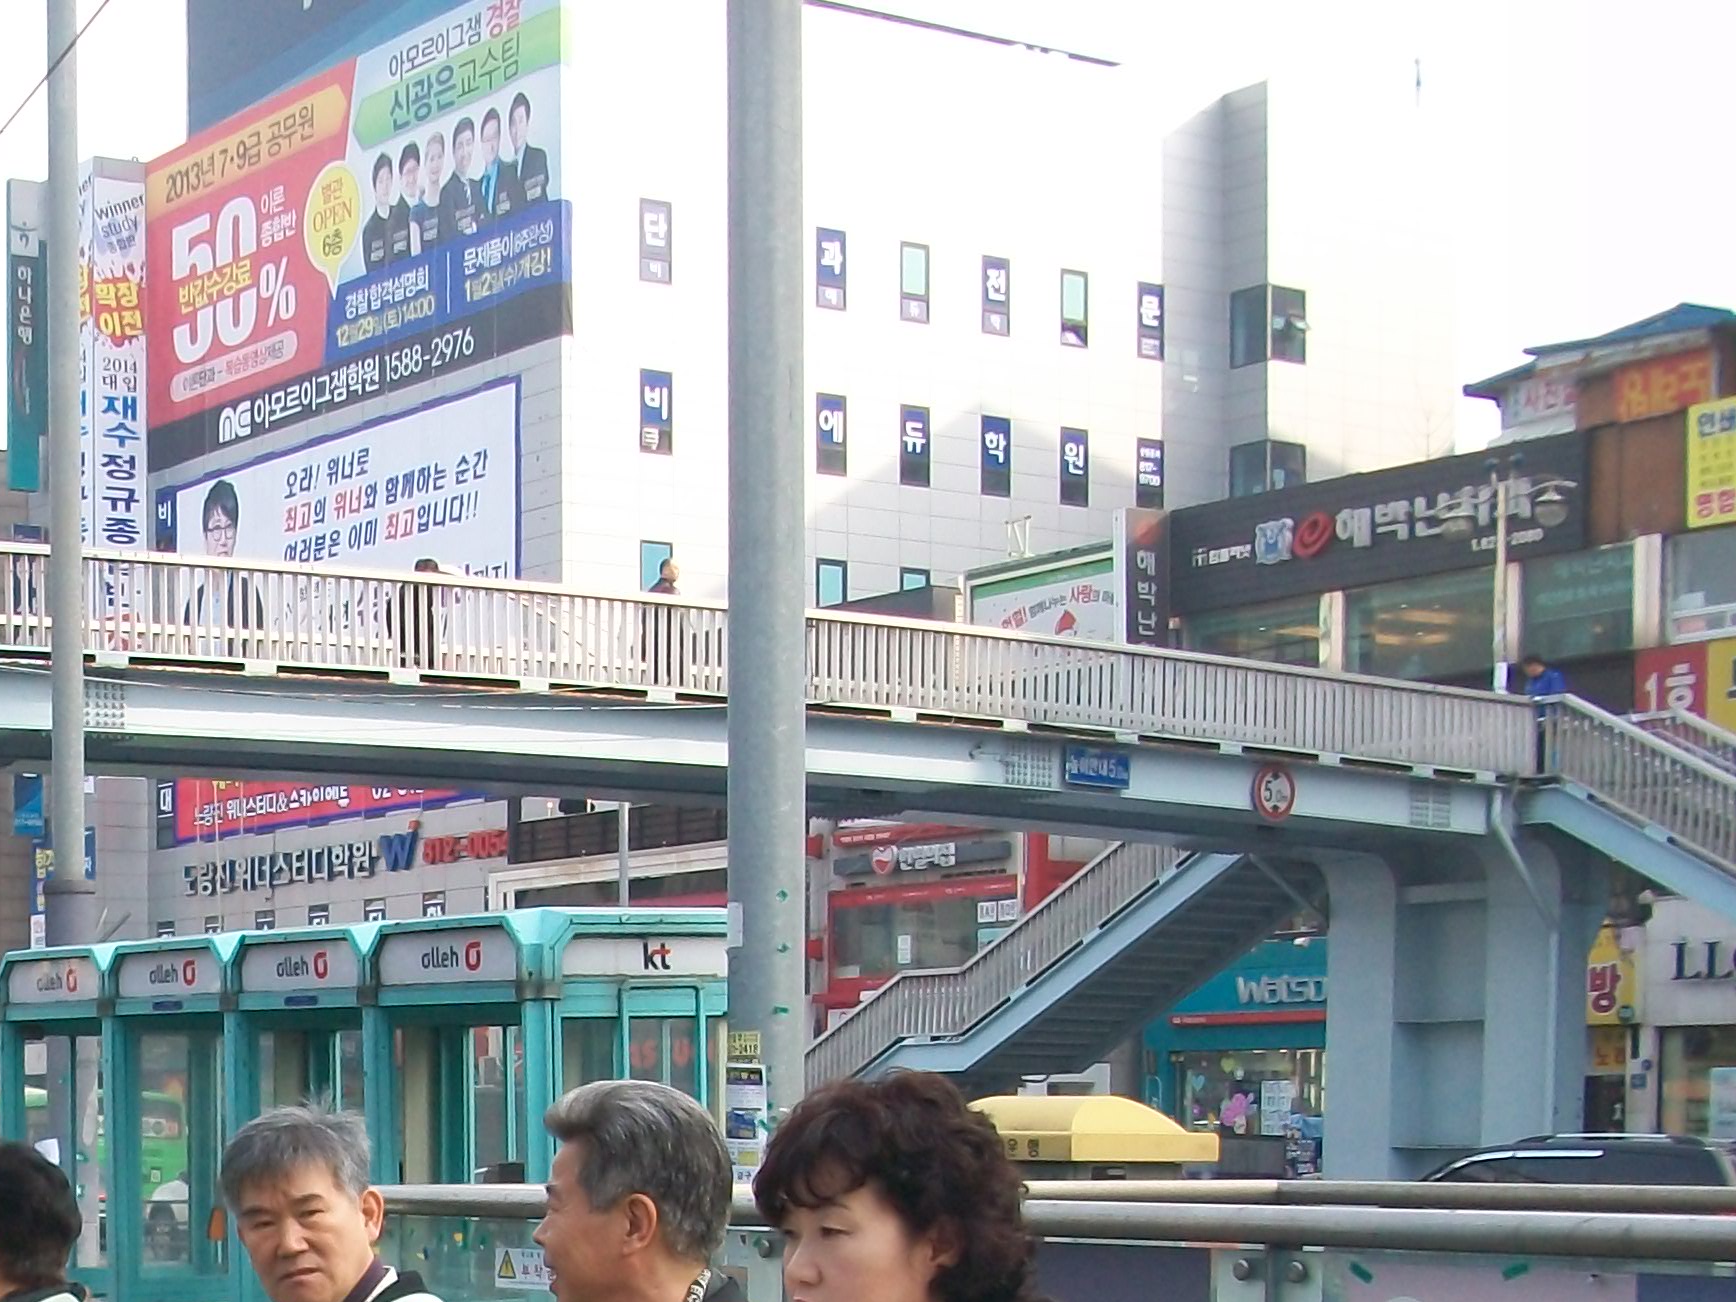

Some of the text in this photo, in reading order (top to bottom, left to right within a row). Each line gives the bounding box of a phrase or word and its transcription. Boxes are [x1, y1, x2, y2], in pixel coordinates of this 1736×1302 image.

[389, 0, 521, 81] 아모르이그잼 경찰
[165, 151, 215, 204] 2013년
[266, 103, 314, 156] 공무원
[94, 194, 146, 221] winner
[314, 198, 353, 233] OPEN
[101, 215, 138, 241] study
[323, 228, 343, 256] 6층
[95, 281, 139, 308] 확장
[179, 259, 252, 315] 반값수강료
[99, 310, 144, 337] 이전
[102, 357, 137, 374] 2014
[253, 327, 474, 428] 아모르이그잼학원 1588-2976
[101, 374, 138, 393] 대입
[284, 447, 370, 499] 오라! 위너로
[284, 448, 489, 533] 최고의 위너와 함께하는 순간
[284, 491, 478, 562] 여러분은 이미 최고입니다!!
[193, 802, 224, 827] 노량진
[276, 956, 309, 979] olleh
[421, 946, 459, 970] olleh
[643, 942, 672, 971] kt
[1670, 940, 1736, 981] LL
[36, 973, 63, 992] olleh
[149, 964, 179, 986] olleh
